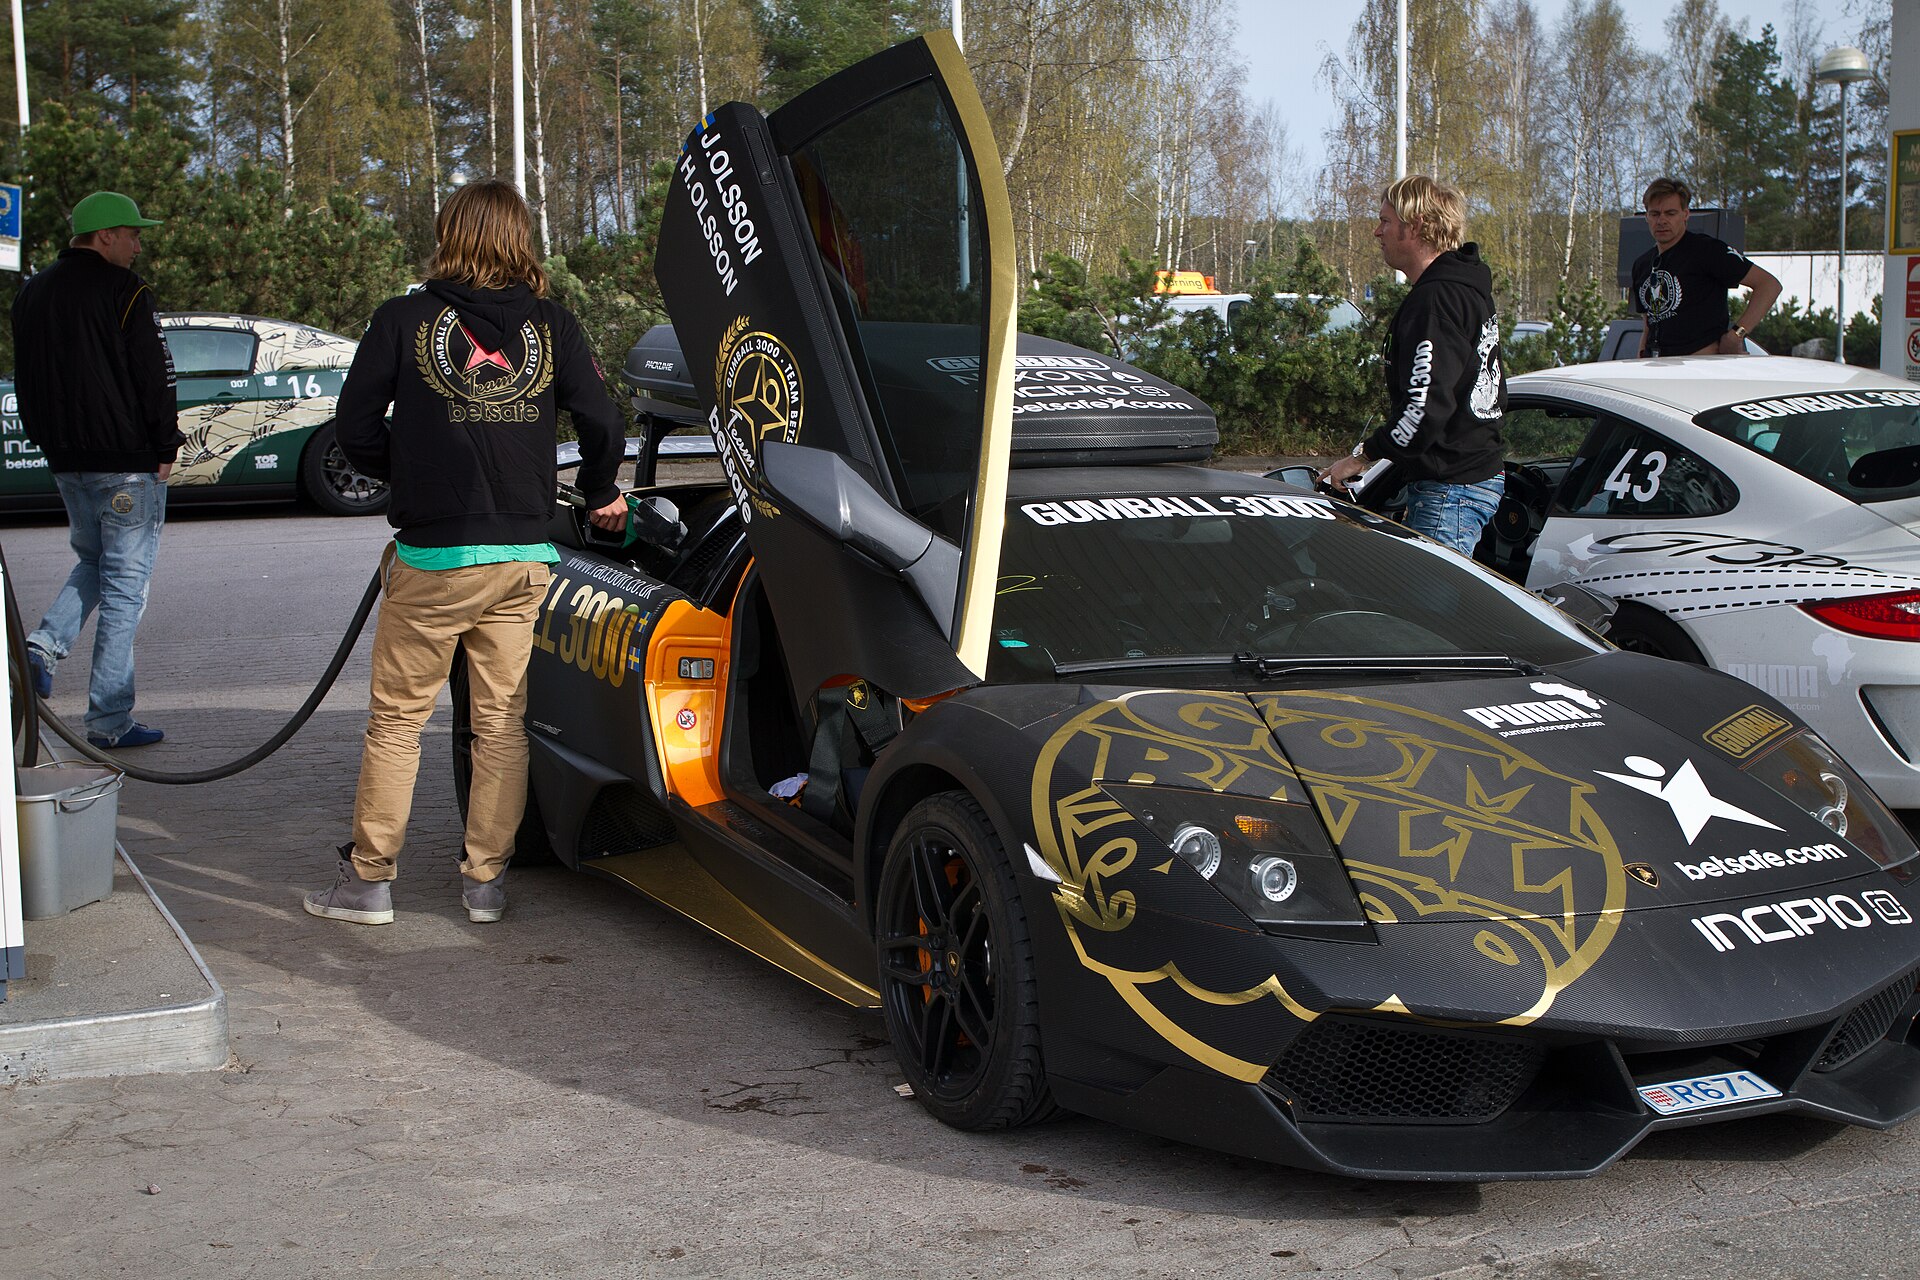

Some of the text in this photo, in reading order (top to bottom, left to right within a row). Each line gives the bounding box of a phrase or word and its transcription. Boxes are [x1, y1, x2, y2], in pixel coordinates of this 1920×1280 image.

[701, 133, 762, 265] J.OLSSON
[680, 154, 738, 297] H.OLSSON
[436, 326, 452, 375] GUMBALL
[525, 349, 538, 375] 2010
[230, 379, 249, 388] 007
[287, 374, 322, 398] 16
[464, 369, 517, 398] Team
[727, 341, 754, 388] GUMBALL
[756, 339, 780, 358] 3000
[784, 363, 799, 404] TEAM
[448, 401, 540, 422] betsafe
[1731, 392, 1885, 421] GUMBALL
[709, 404, 752, 524] betsafe
[1604, 448, 1668, 502] 43
[1020, 495, 1337, 527] GUMBALL 3000
[559, 584, 640, 688] 3000
[1462, 699, 1594, 730] PUMA
[1711, 708, 1786, 753] GUMBALL
[1674, 842, 1848, 881] betsafe.com
[1690, 894, 1872, 953] INCIPIO
[1667, 1074, 1768, 1104] R671
